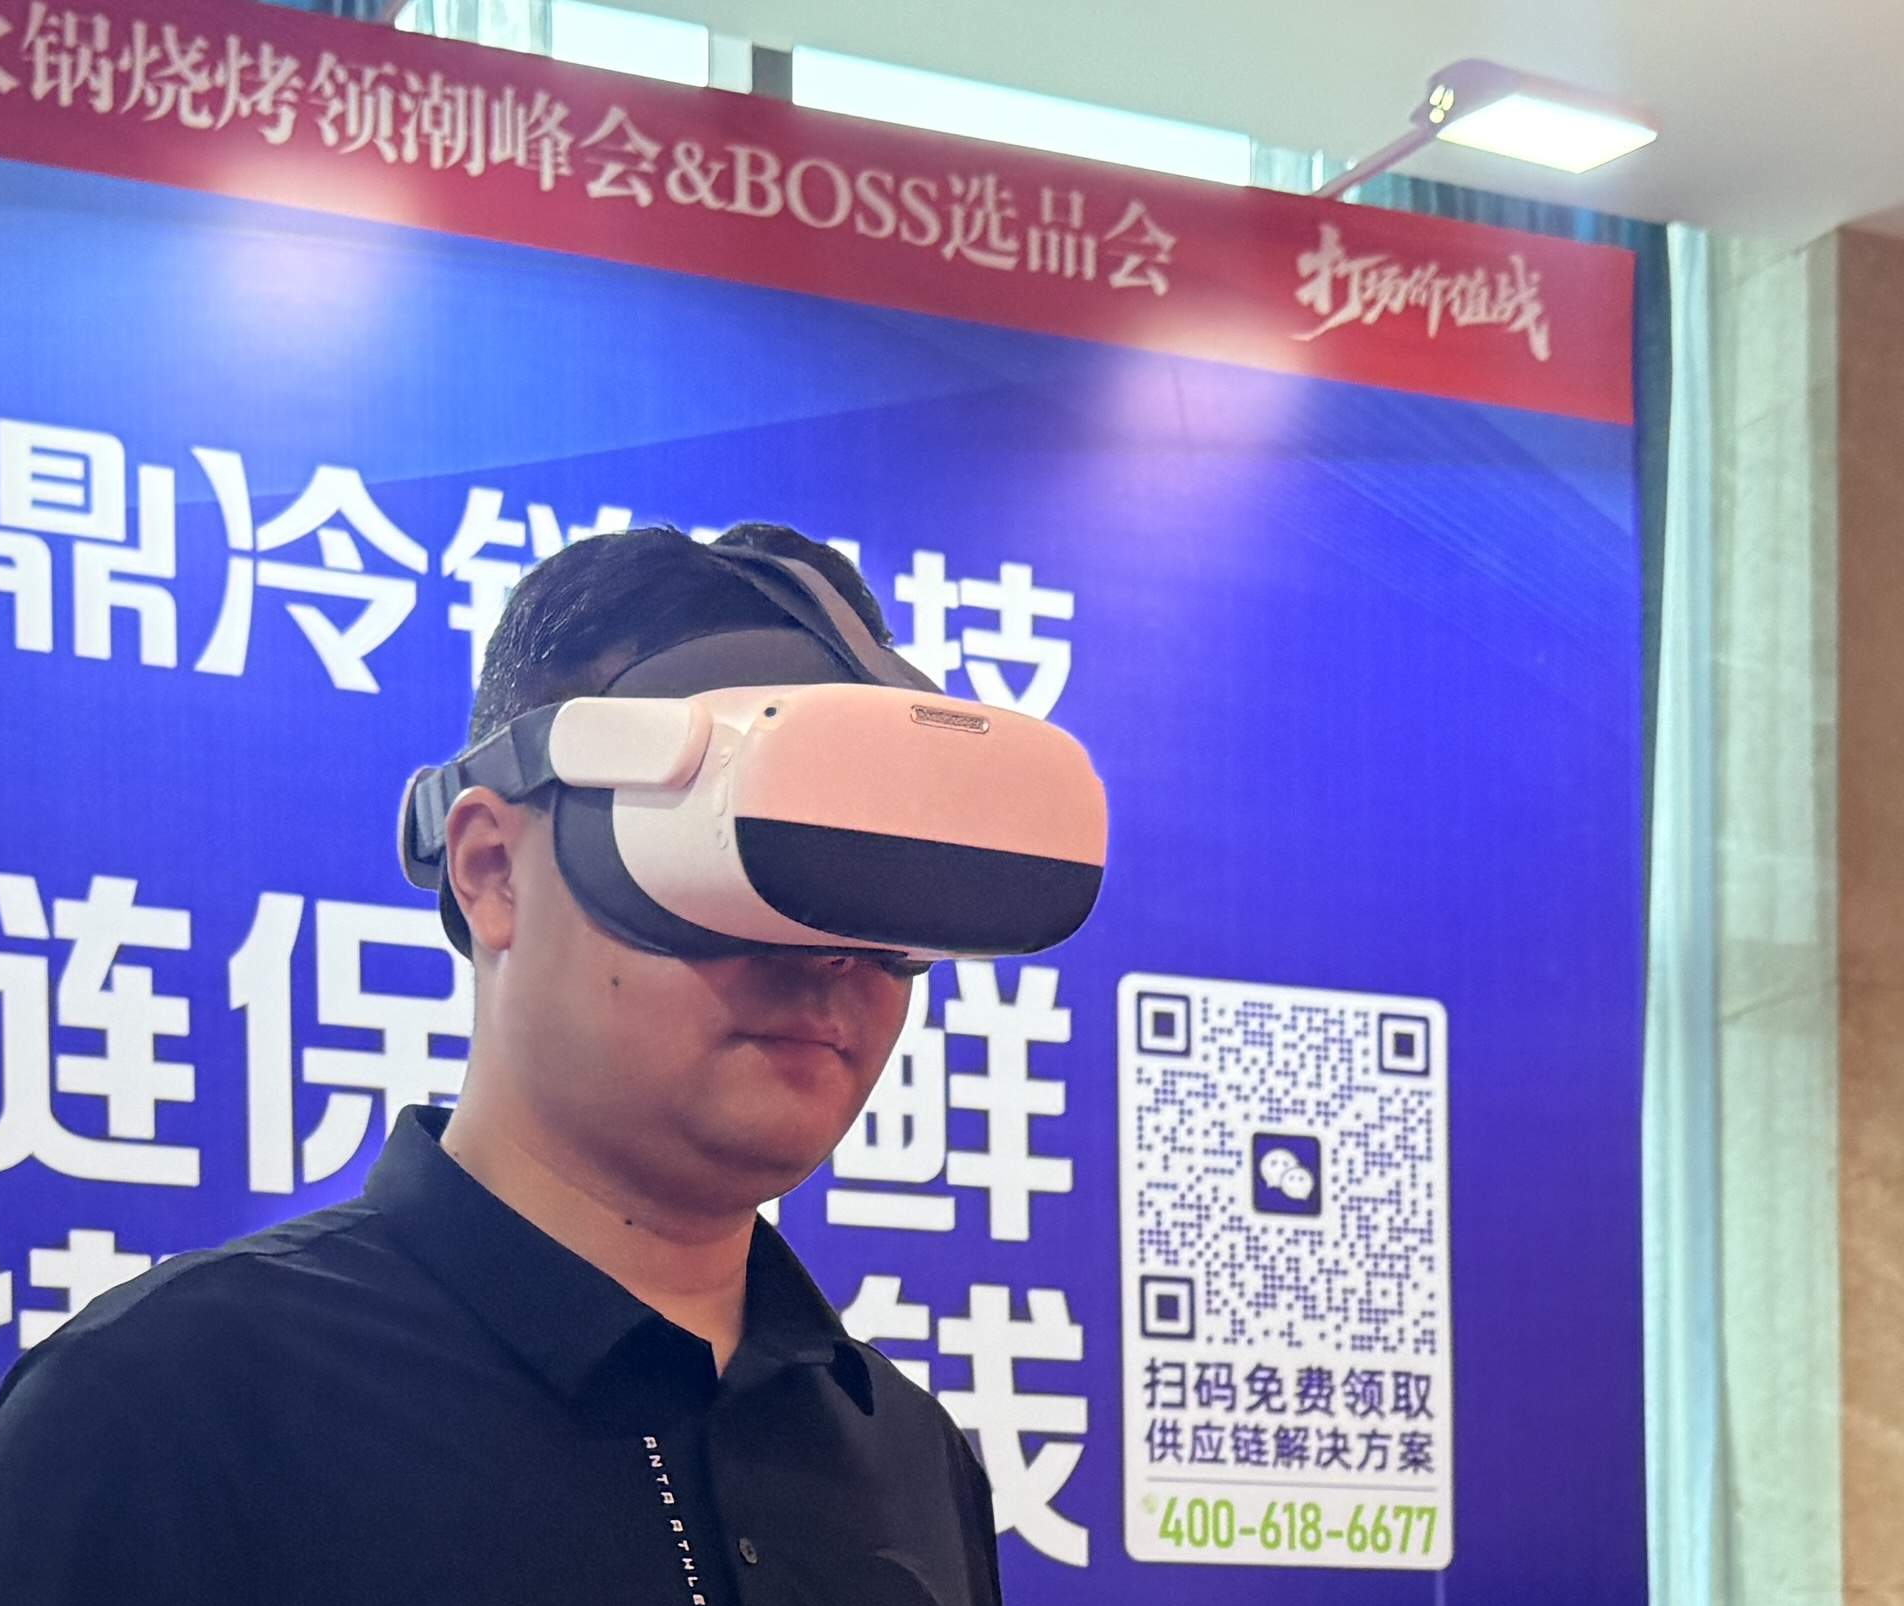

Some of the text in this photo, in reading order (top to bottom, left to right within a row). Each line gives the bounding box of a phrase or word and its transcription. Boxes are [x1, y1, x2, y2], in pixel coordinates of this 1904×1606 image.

[1142, 1356, 1434, 1420] 扫码免费领取
[1143, 1418, 1436, 1474] 供应链解决方案
[1158, 1496, 1438, 1556] 400-618-6677
